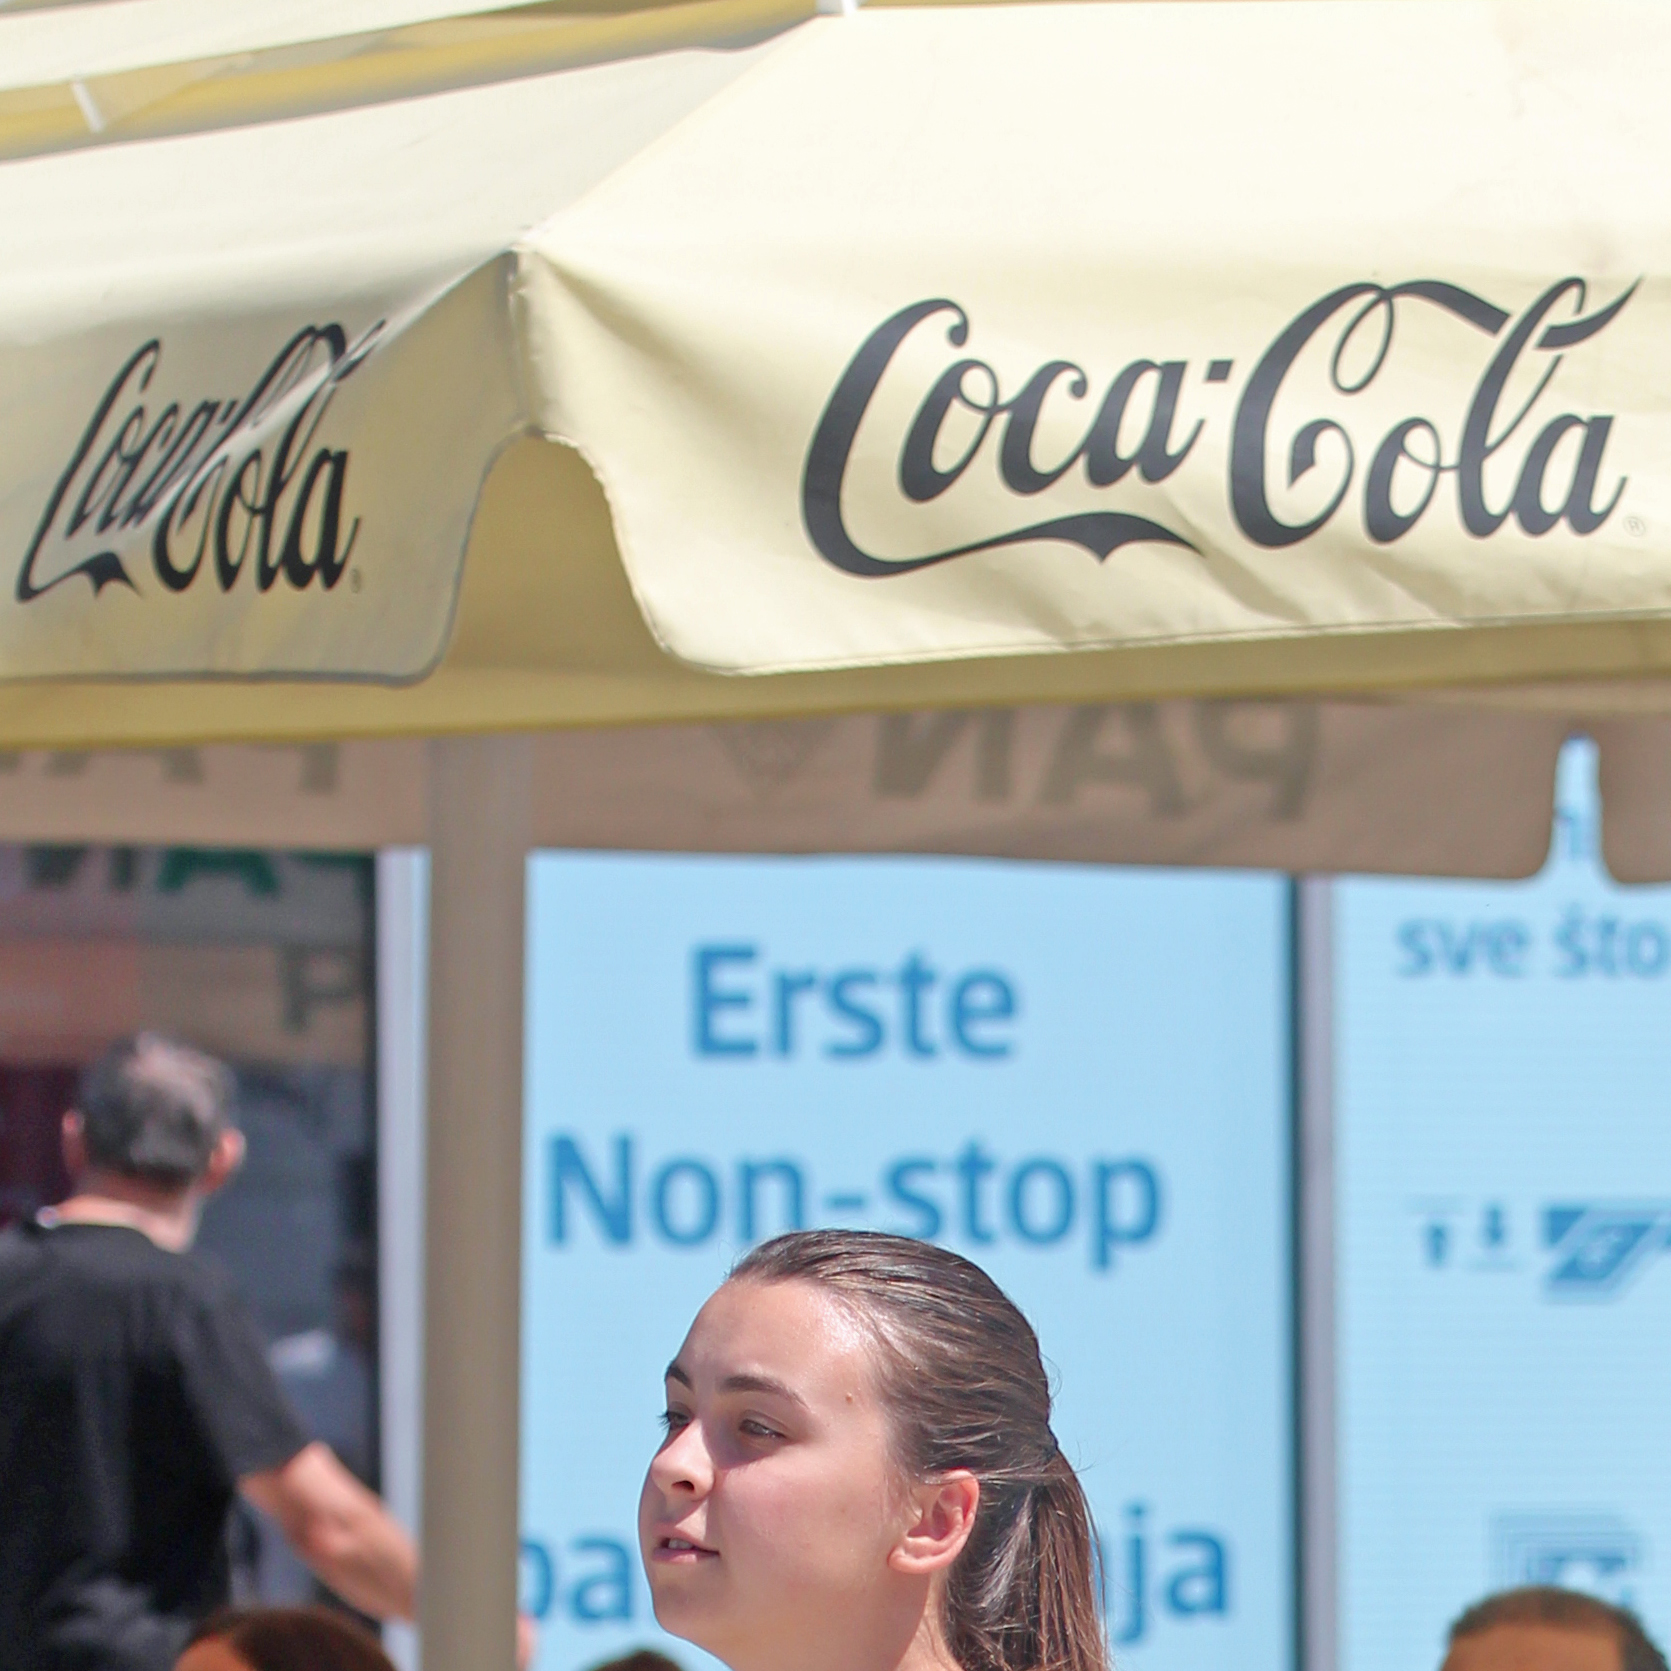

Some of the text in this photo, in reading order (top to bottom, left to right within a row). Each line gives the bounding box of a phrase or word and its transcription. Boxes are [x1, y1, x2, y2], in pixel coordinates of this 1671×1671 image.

[801, 273, 1645, 578] Coca-Cola
[690, 943, 1020, 1060] Erste
[1396, 915, 1530, 980] sve
[543, 1128, 1167, 1274] Non-stop
